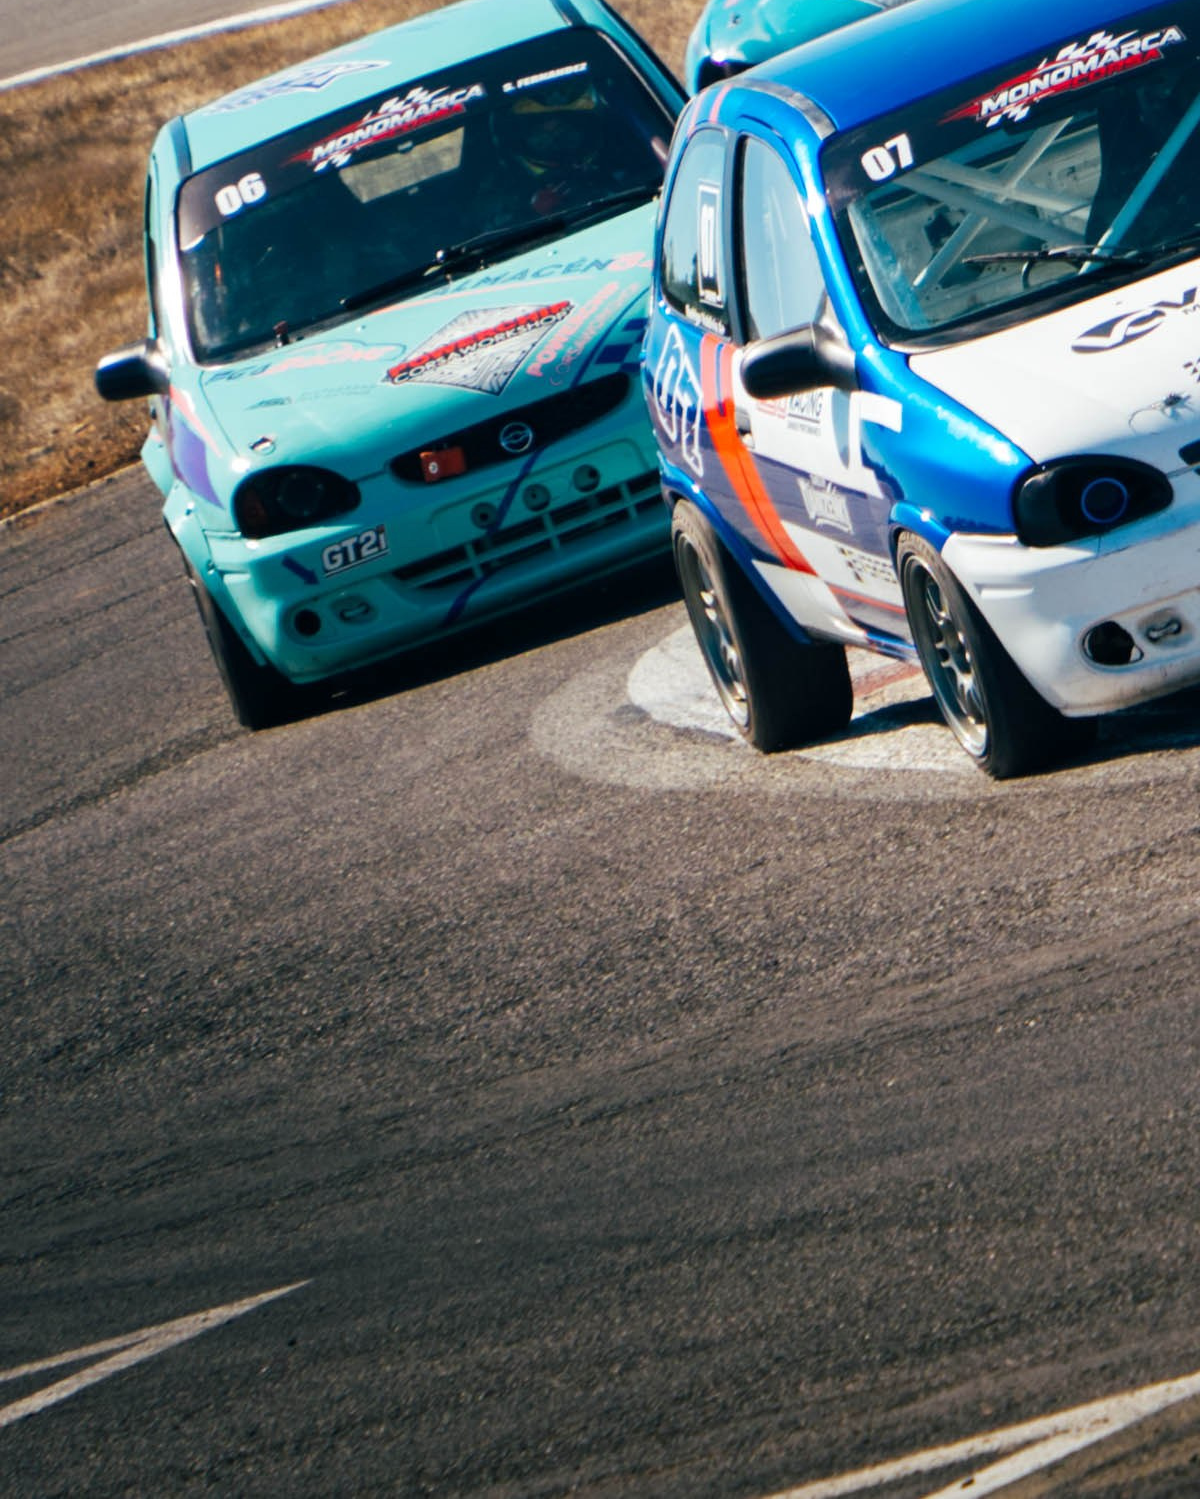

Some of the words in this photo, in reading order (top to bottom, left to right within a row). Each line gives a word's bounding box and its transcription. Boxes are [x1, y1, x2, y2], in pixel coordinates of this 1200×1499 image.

[980, 25, 1184, 117] MONOMARCA
[311, 84, 485, 163] MONOMARCA
[861, 133, 914, 183] 07
[215, 171, 267, 217] 06
[392, 304, 576, 386] CORSAWORKSHOP
[322, 524, 387, 572] GT2i
